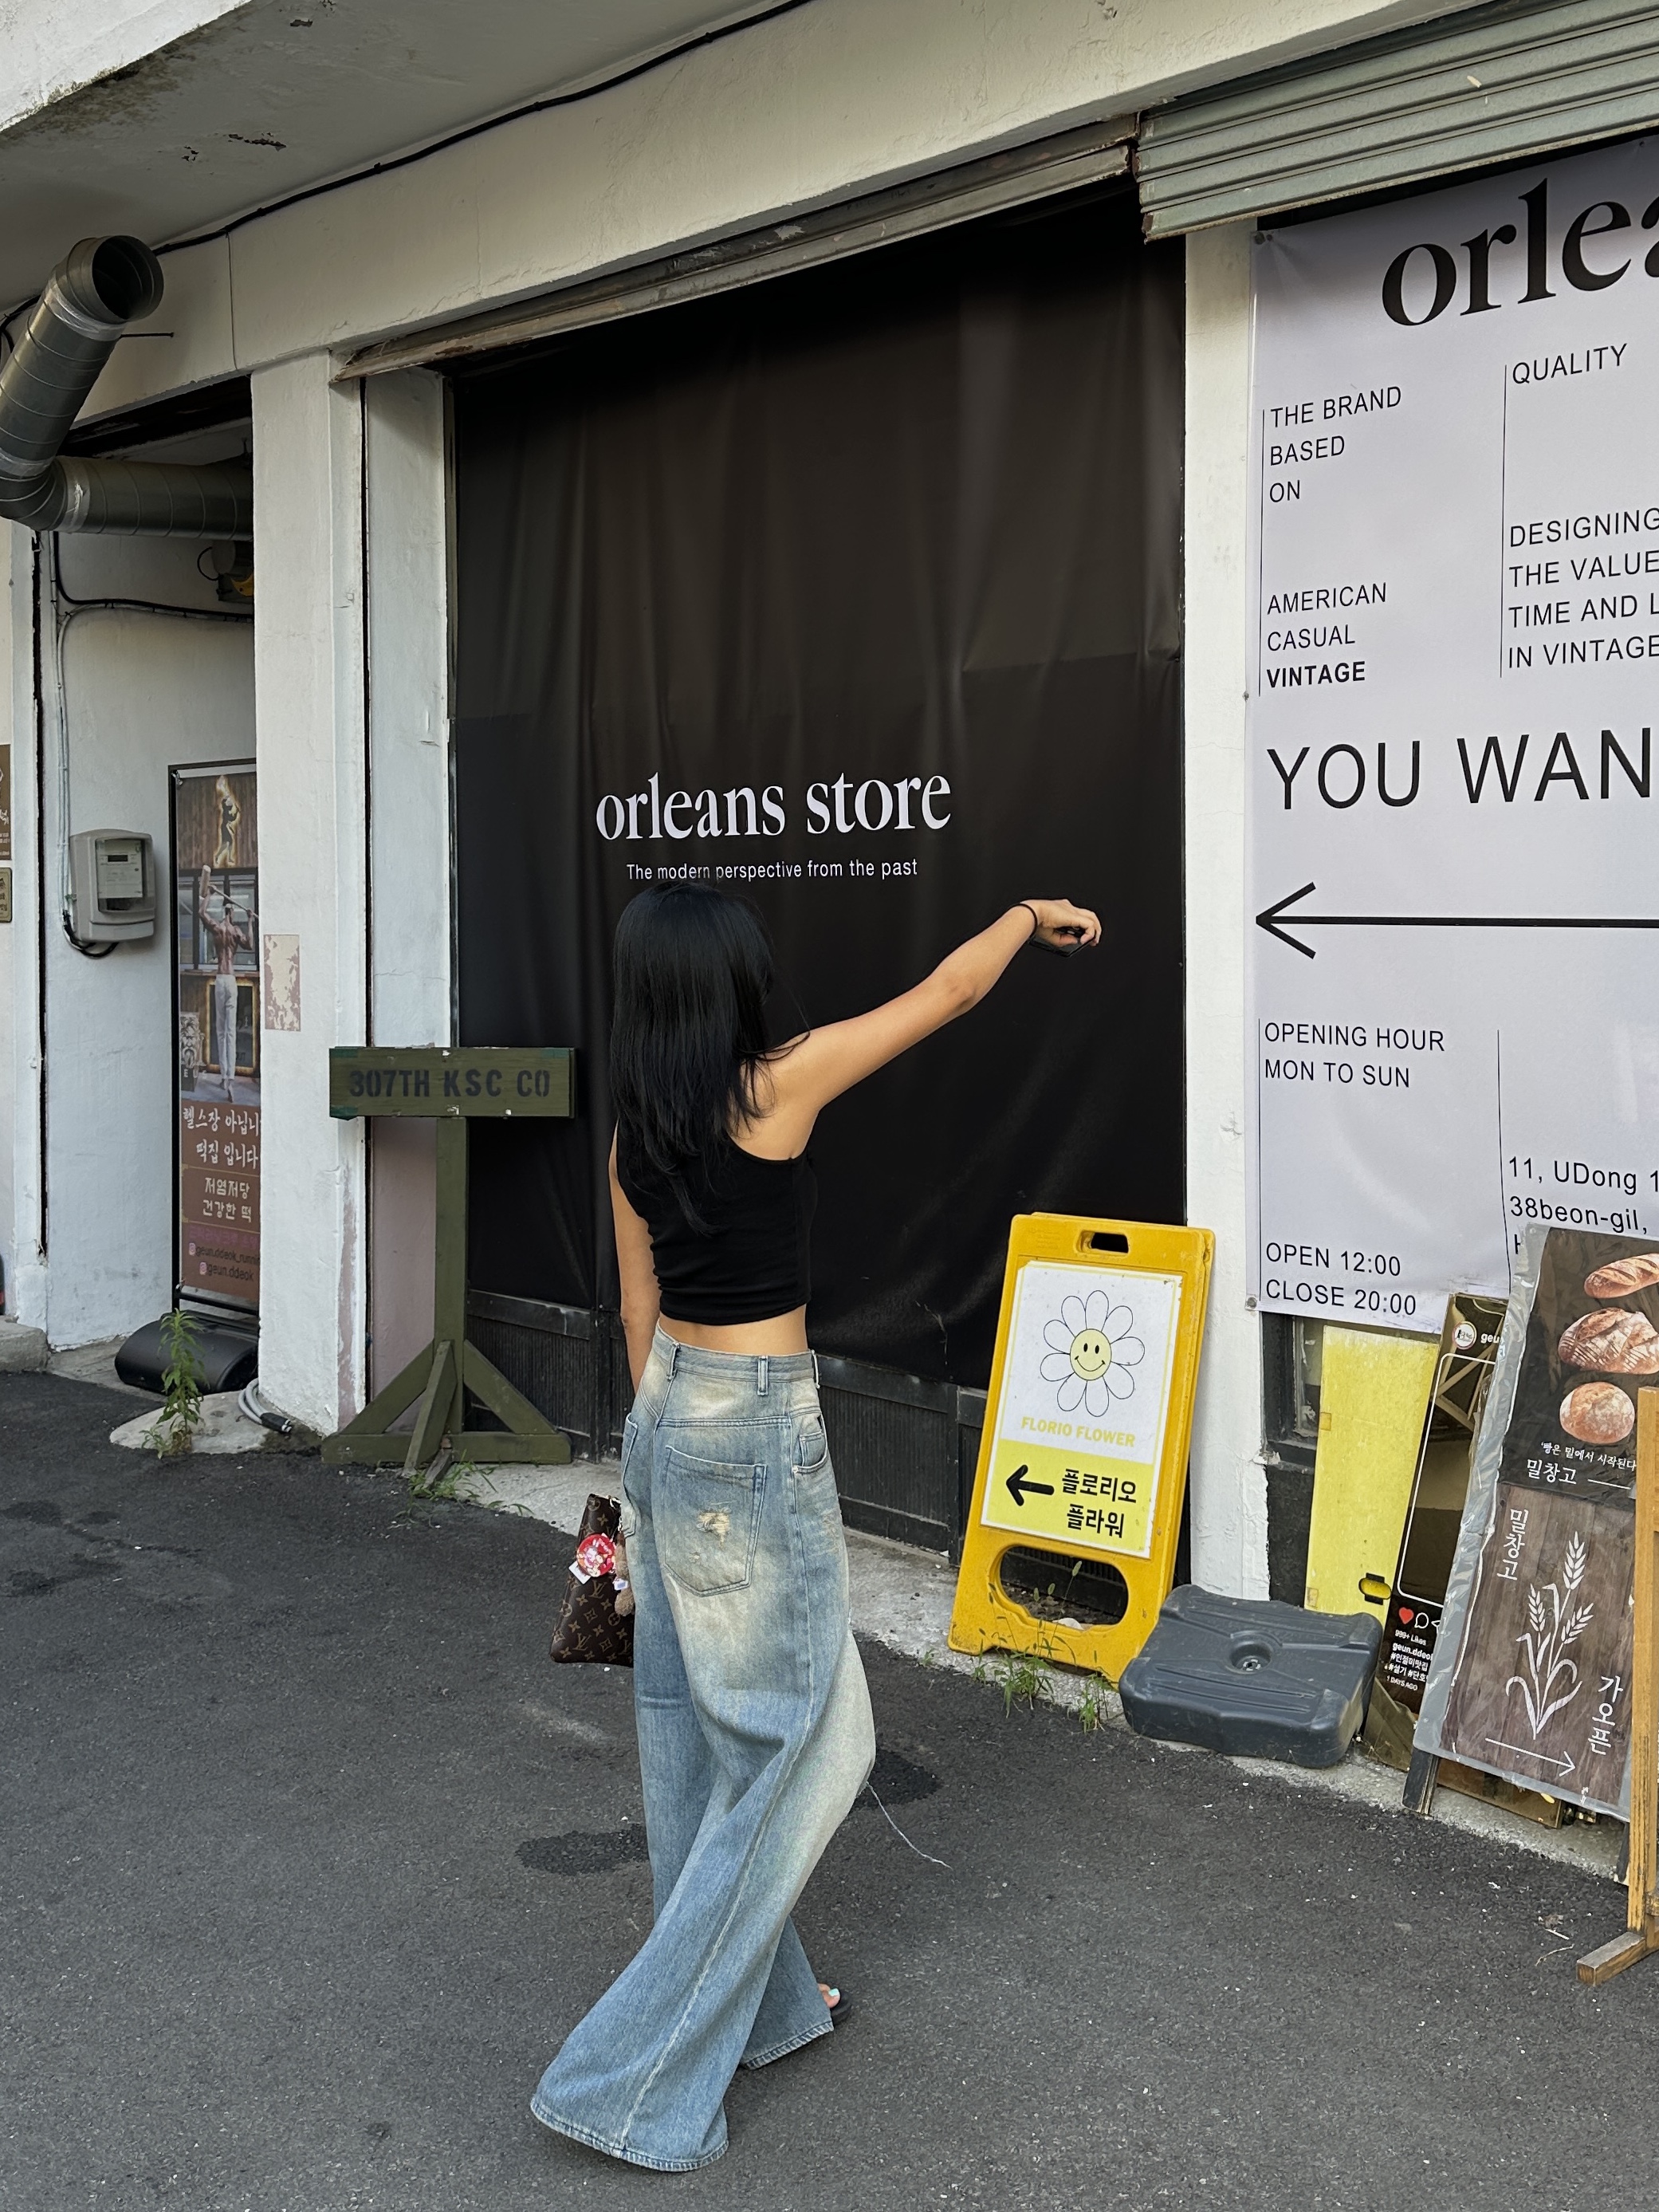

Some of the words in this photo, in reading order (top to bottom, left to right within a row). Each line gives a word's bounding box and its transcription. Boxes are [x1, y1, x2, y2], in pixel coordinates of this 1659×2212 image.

[1512, 343, 1627, 384] QUALITY
[1270, 403, 1315, 428] THE
[1323, 386, 1402, 420] BRAND
[1270, 435, 1345, 466] BASED
[1269, 479, 1300, 503] ON
[1510, 507, 1659, 549] DESIGNING
[1508, 561, 1559, 588] THE
[1570, 549, 1659, 581] VALUE
[1267, 582, 1386, 616] AMERICAN
[1508, 600, 1571, 628] TIME
[1580, 595, 1637, 622] AND
[1268, 624, 1356, 651] CASUAL
[1509, 645, 1532, 669] IN
[1543, 634, 1659, 666] VINTAGE
[1266, 660, 1366, 688] VINTAGE
[1266, 740, 1421, 810] YOU
[1457, 727, 1651, 804] WAN
[596, 772, 785, 840] orleans
[806, 772, 951, 834] store
[626, 864, 653, 880] The
[657, 862, 710, 880] modern
[715, 860, 802, 883] perspective
[807, 860, 843, 878] from
[849, 859, 875, 877] the
[881, 858, 918, 880] past
[1264, 1022, 1366, 1048] OPENING
[1377, 1027, 1445, 1053] HOUR
[349, 1069, 430, 1098] 307TH
[443, 1069, 503, 1098] KSC
[516, 1069, 550, 1098] CO
[1265, 1058, 1314, 1081] MON
[1323, 1061, 1354, 1084] TO
[1362, 1065, 1409, 1088] SUN
[183, 1105, 221, 1132] 헬스장
[225, 1109, 261, 1137] 아닙니
[196, 1139, 218, 1164] 떡집
[223, 1141, 259, 1170] 입니다
[203, 1177, 250, 1200] 저염저당
[1509, 1155, 1543, 1184] 11,
[1554, 1160, 1637, 1196] UDong
[202, 1199, 237, 1220] 건강한
[241, 1205, 252, 1223] 떡
[1510, 1195, 1647, 1234] 38beon-gil,
[1266, 1242, 1330, 1269] OPEN
[1340, 1250, 1401, 1277] 12:00
[1266, 1279, 1345, 1307] CLOSE
[1354, 1289, 1416, 1316] 20:00
[1020, 1416, 1073, 1436] FLORIO
[1075, 1425, 1136, 1447] FLOWER
[1565, 1446, 1594, 1463] 밀에서
[1061, 1468, 1137, 1504] 플로리오
[1527, 1458, 1577, 1485] 밀창고
[1067, 1503, 1125, 1539] 플라워
[1496, 1508, 1529, 1580] 밀창고
[1407, 1669, 1429, 1683] #단호
[1587, 1675, 1624, 1756] 가오픈
